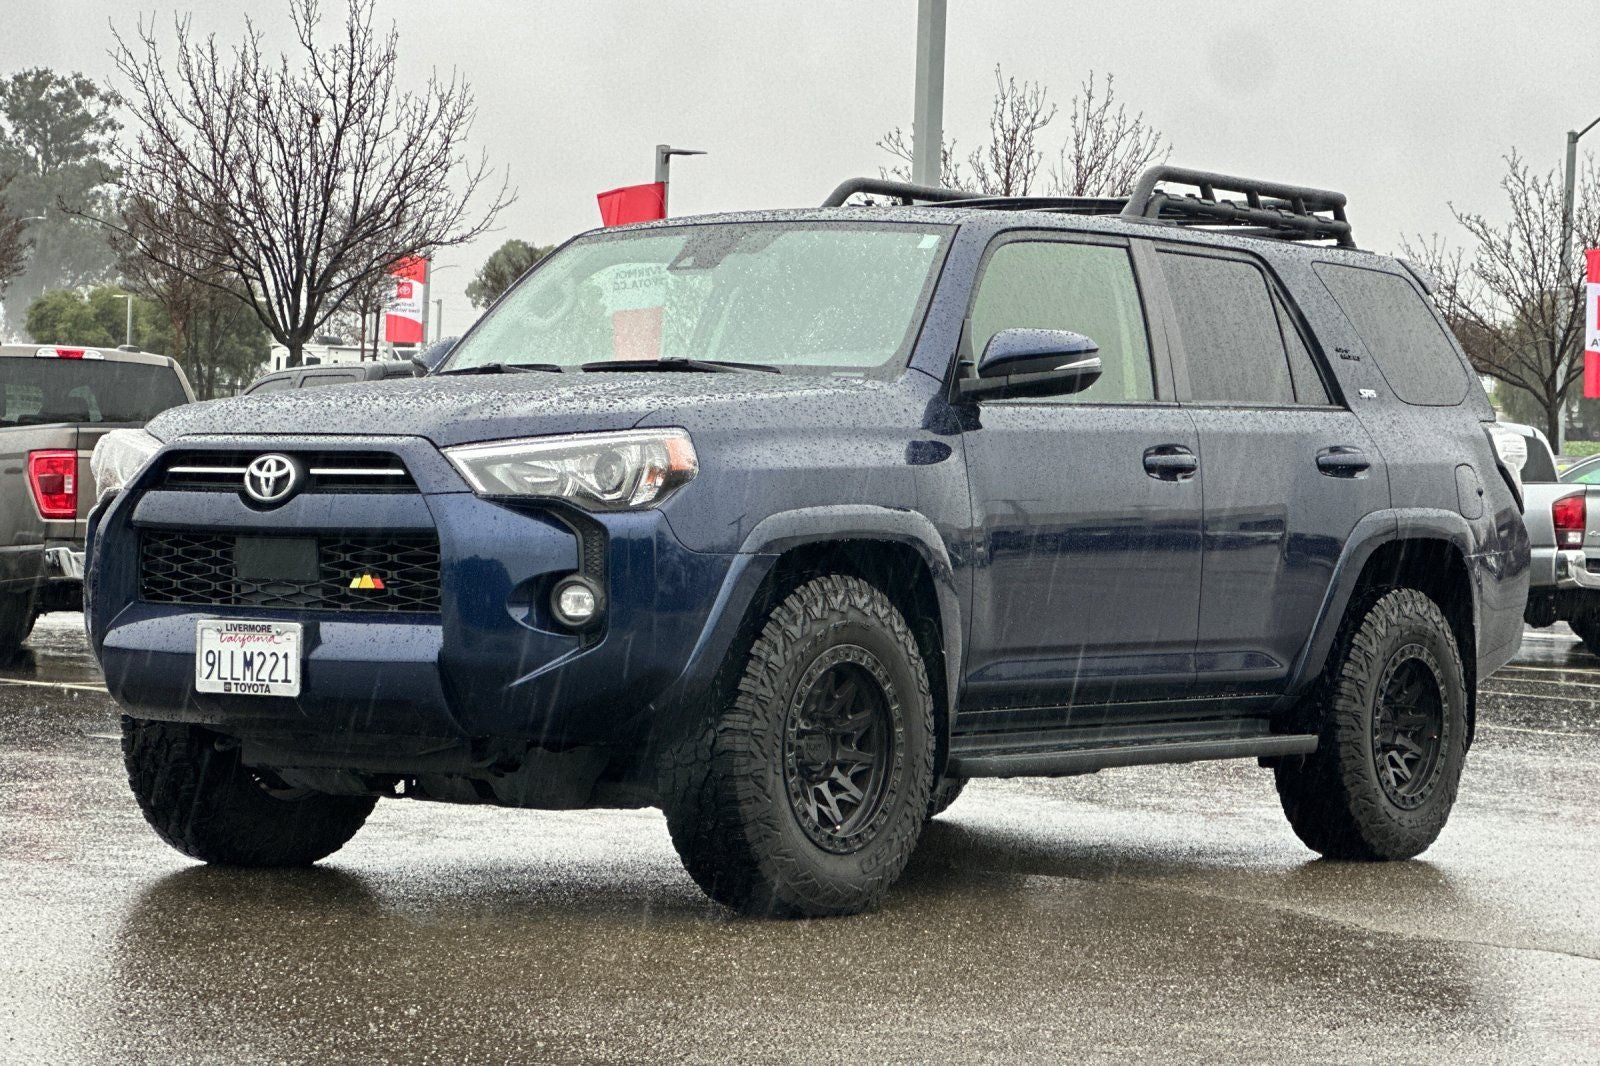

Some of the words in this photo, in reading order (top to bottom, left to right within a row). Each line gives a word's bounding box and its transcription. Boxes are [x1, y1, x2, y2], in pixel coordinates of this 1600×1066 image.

[225, 623, 272, 633] LIVERMORE
[220, 632, 281, 648] California
[205, 649, 292, 684] 9LLM221
[233, 682, 271, 694] TOYOTA
